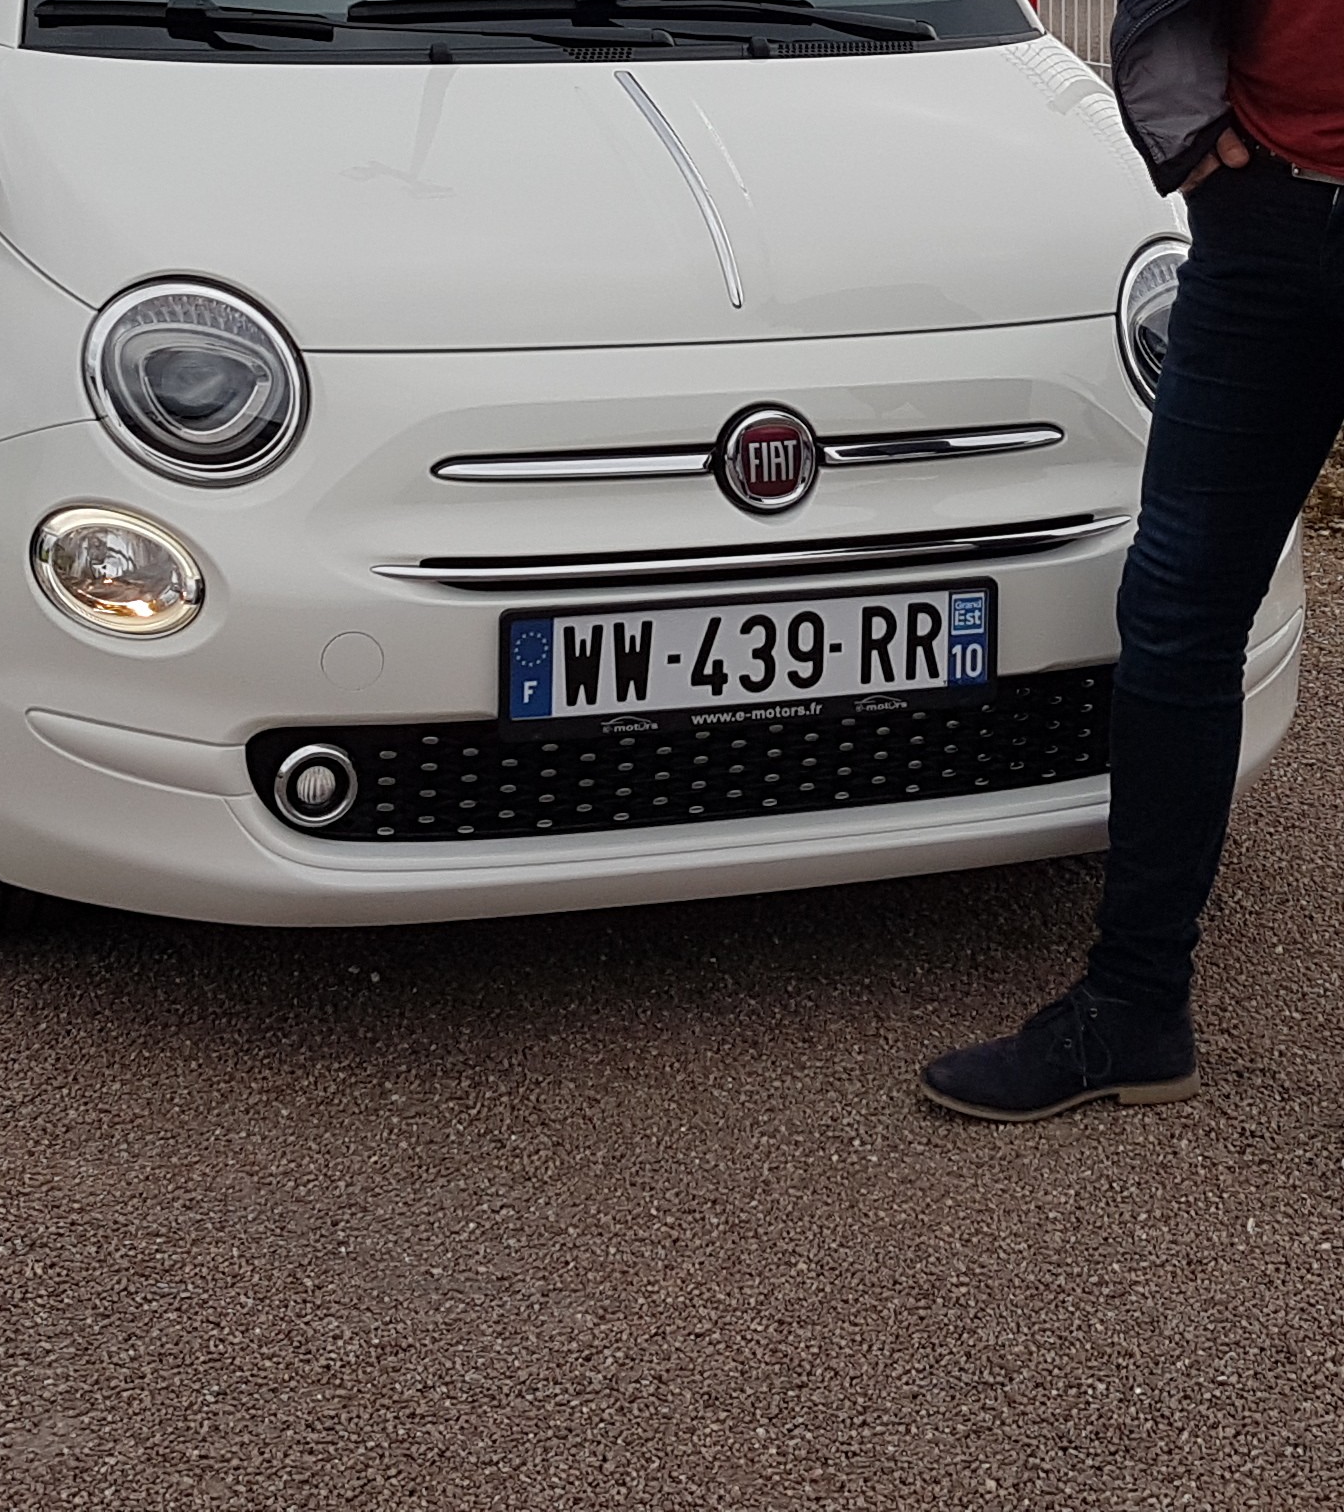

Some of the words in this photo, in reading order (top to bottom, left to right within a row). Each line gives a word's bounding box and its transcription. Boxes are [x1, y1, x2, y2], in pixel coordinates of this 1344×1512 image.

[748, 440, 798, 484] FIAT
[955, 599, 983, 610] Grand
[954, 609, 982, 626] Est
[951, 643, 983, 679] 10
[523, 680, 538, 704] F
[691, 701, 823, 725] www.e-motors.fr
